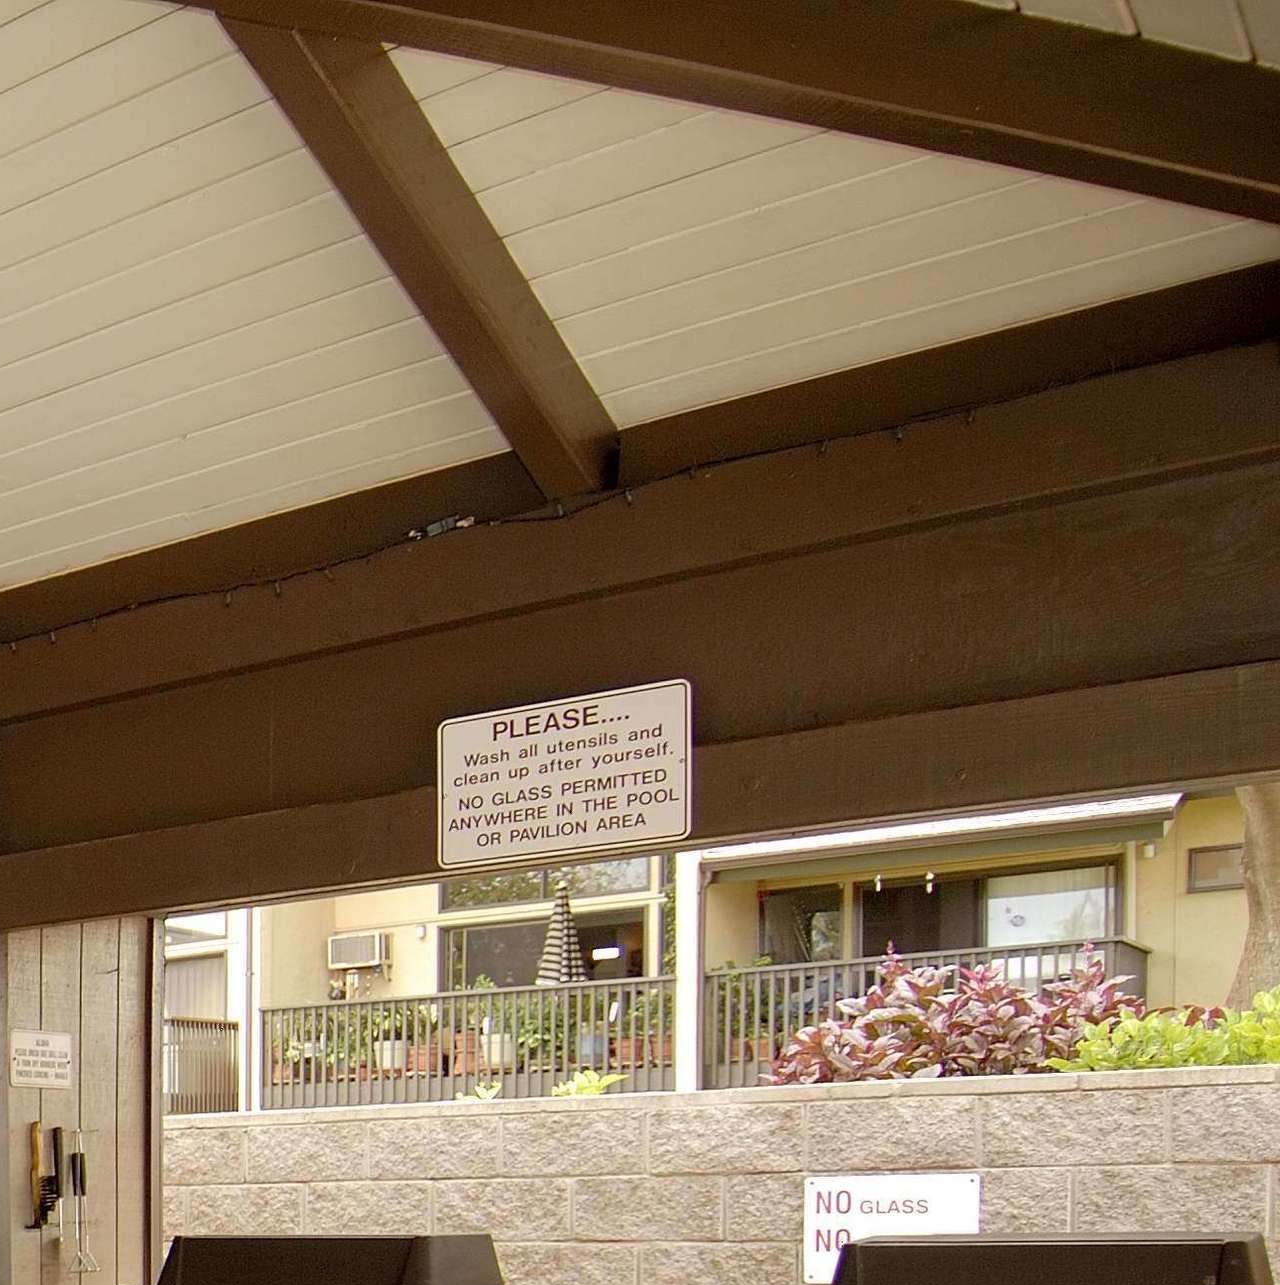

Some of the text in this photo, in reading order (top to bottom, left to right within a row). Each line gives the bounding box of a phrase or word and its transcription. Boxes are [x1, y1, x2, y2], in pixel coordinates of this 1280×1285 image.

[454, 742, 674, 787] clean up after yourself.
[464, 724, 663, 767] Wash all utensils and
[448, 788, 680, 832] ANYWHERE IN THE POOL
[458, 768, 667, 811] NO GLASS PERMITTED
[476, 812, 646, 847] OR PAVILION AREA
[816, 1190, 929, 1214] NO GLASS
